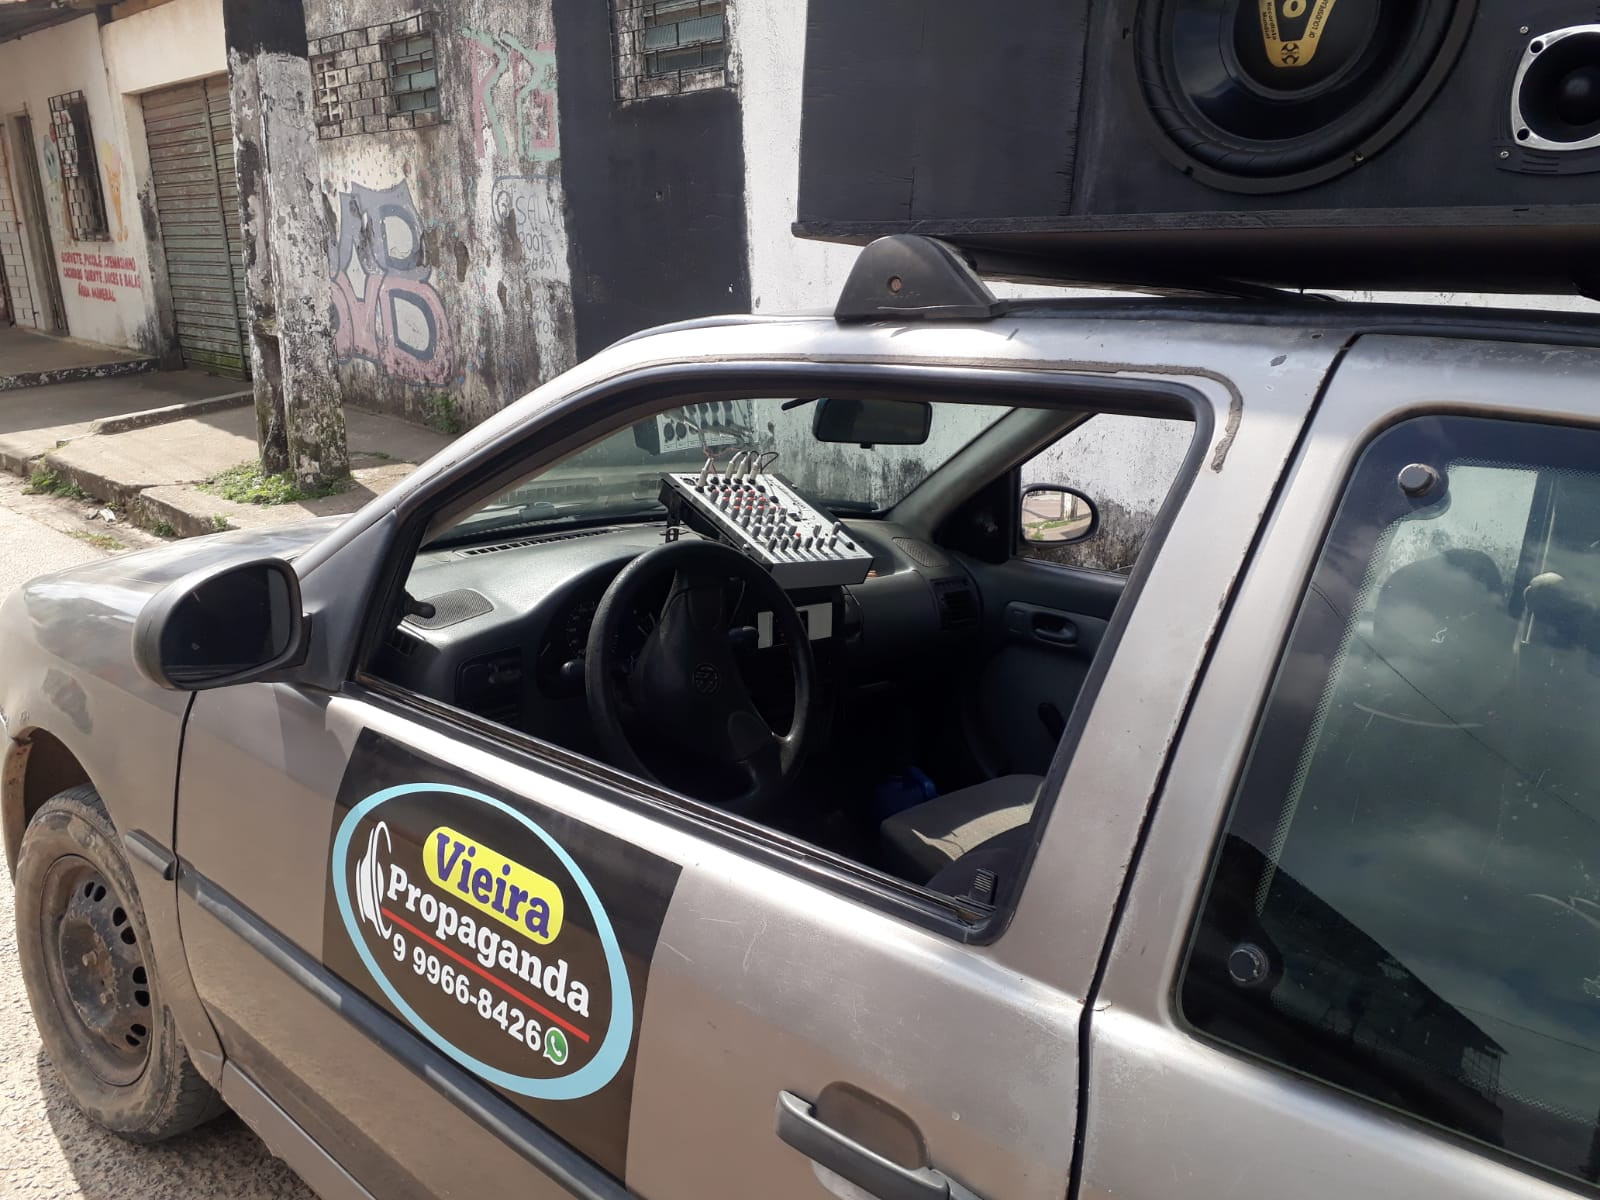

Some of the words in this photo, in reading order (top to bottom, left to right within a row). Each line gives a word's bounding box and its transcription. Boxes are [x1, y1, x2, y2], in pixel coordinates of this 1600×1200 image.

[387, 864, 590, 1018] Propaganda
[436, 832, 550, 939] Vieira
[392, 932, 407, 963] 9
[412, 946, 543, 1053] 9966-8426
